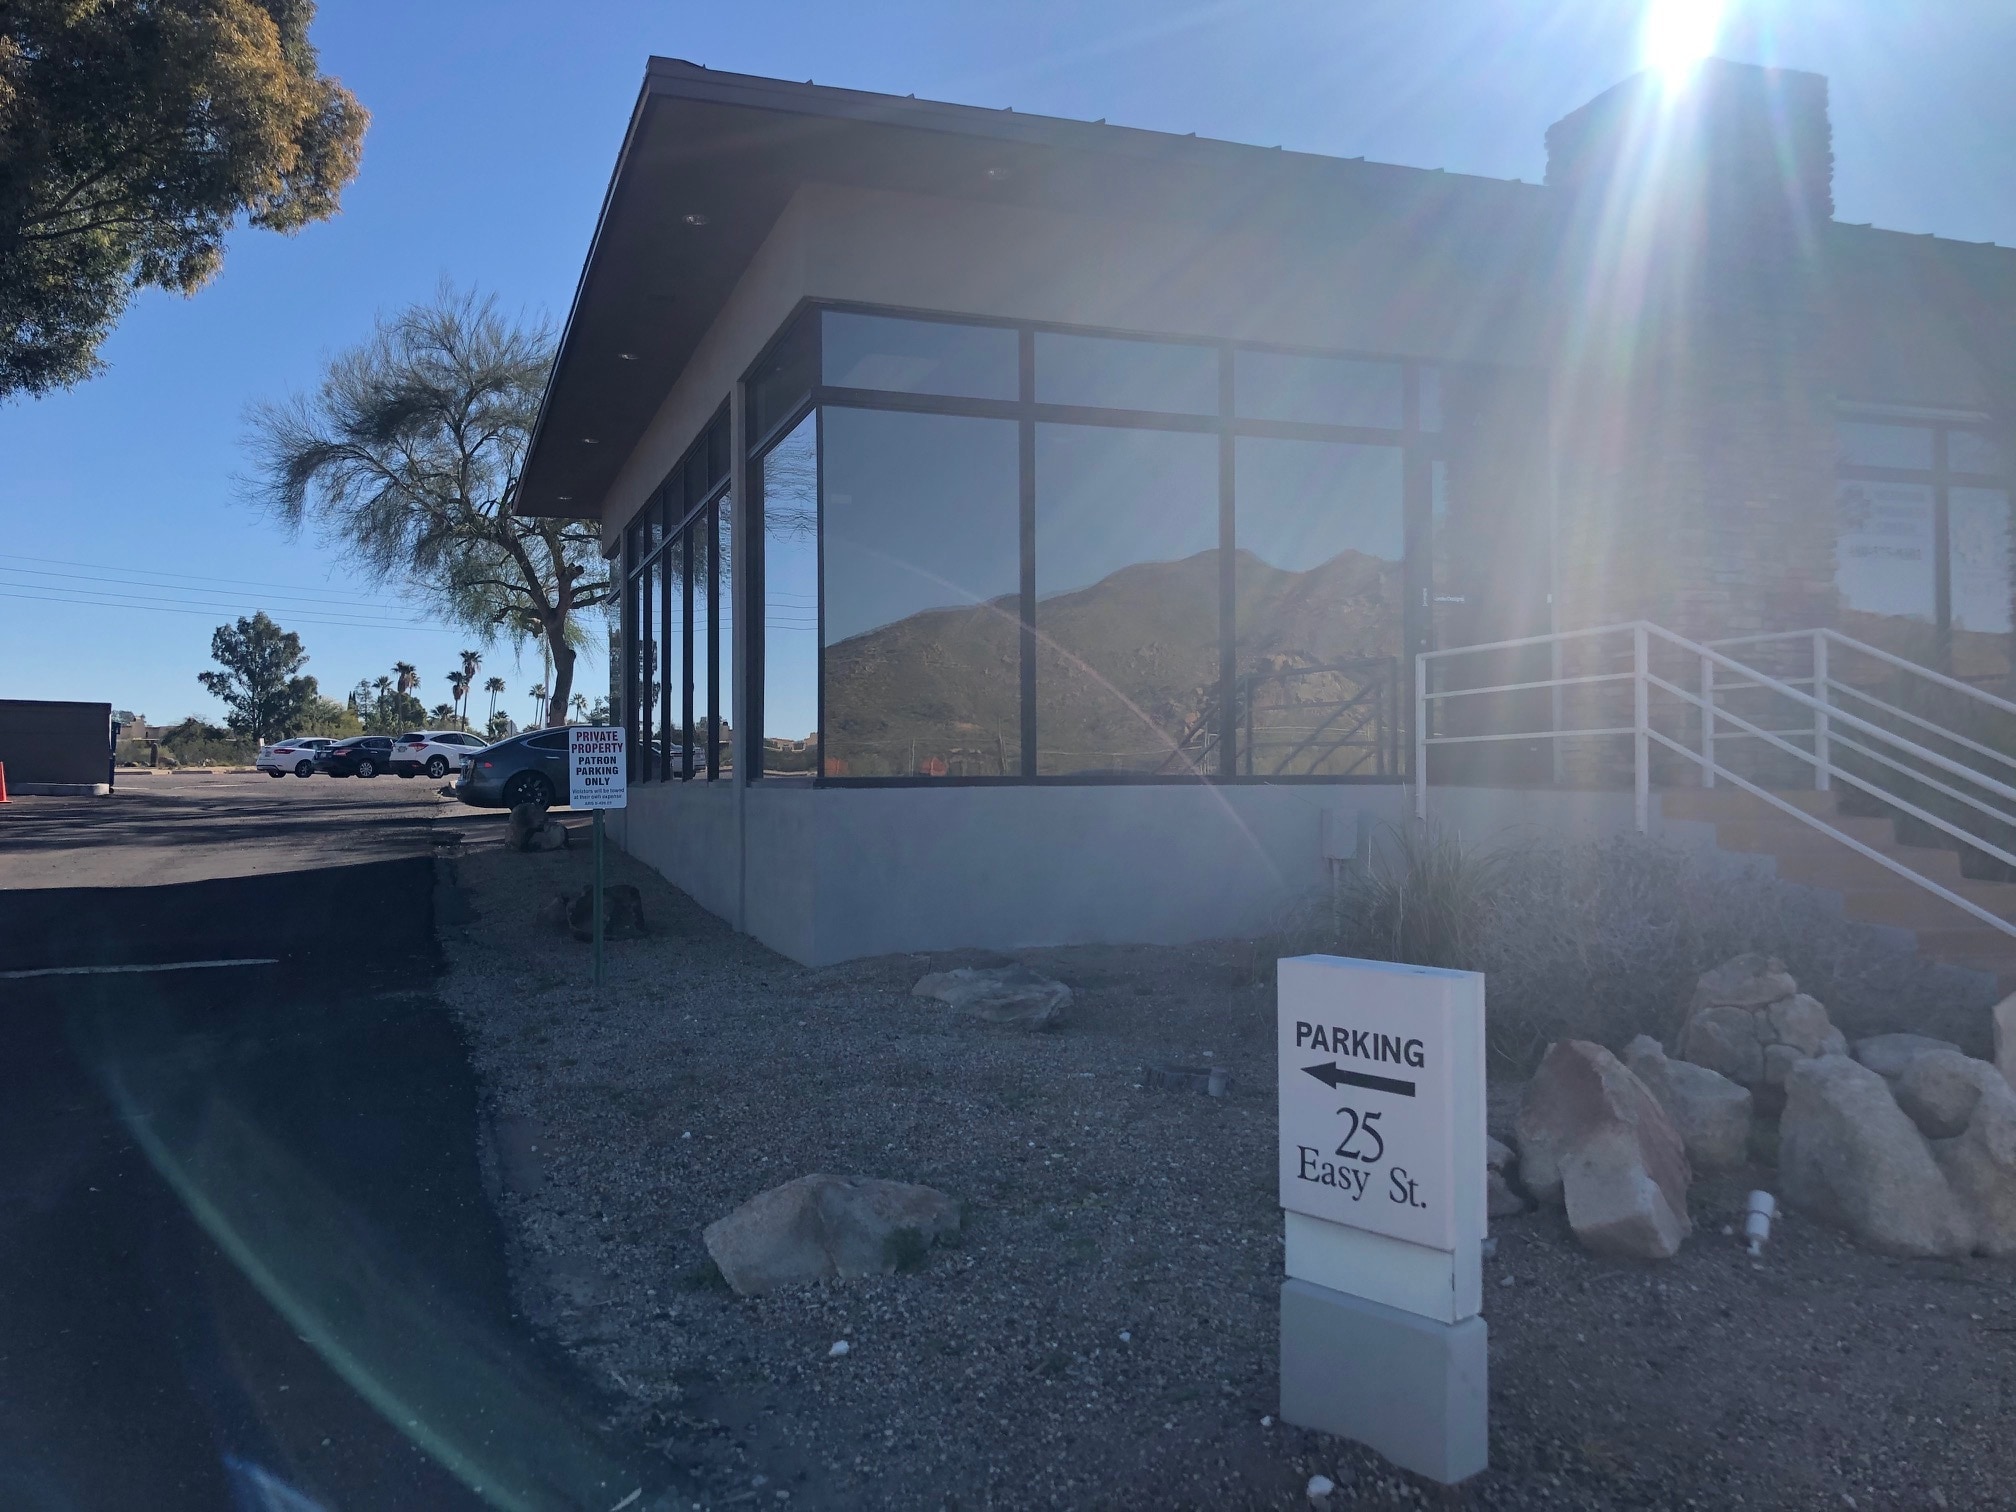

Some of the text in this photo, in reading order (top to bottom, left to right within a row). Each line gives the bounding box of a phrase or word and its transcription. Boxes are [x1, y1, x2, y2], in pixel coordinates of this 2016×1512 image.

[576, 731, 618, 742] PRIVATE
[571, 743, 623, 753] PROPERTY
[578, 756, 616, 765] PATRON
[576, 766, 618, 775] PARKING
[585, 777, 610, 786] ONLY
[1296, 1021, 1425, 1069] PARKING
[1335, 1107, 1384, 1163] 25
[1296, 1144, 1427, 1209] Easy St.
